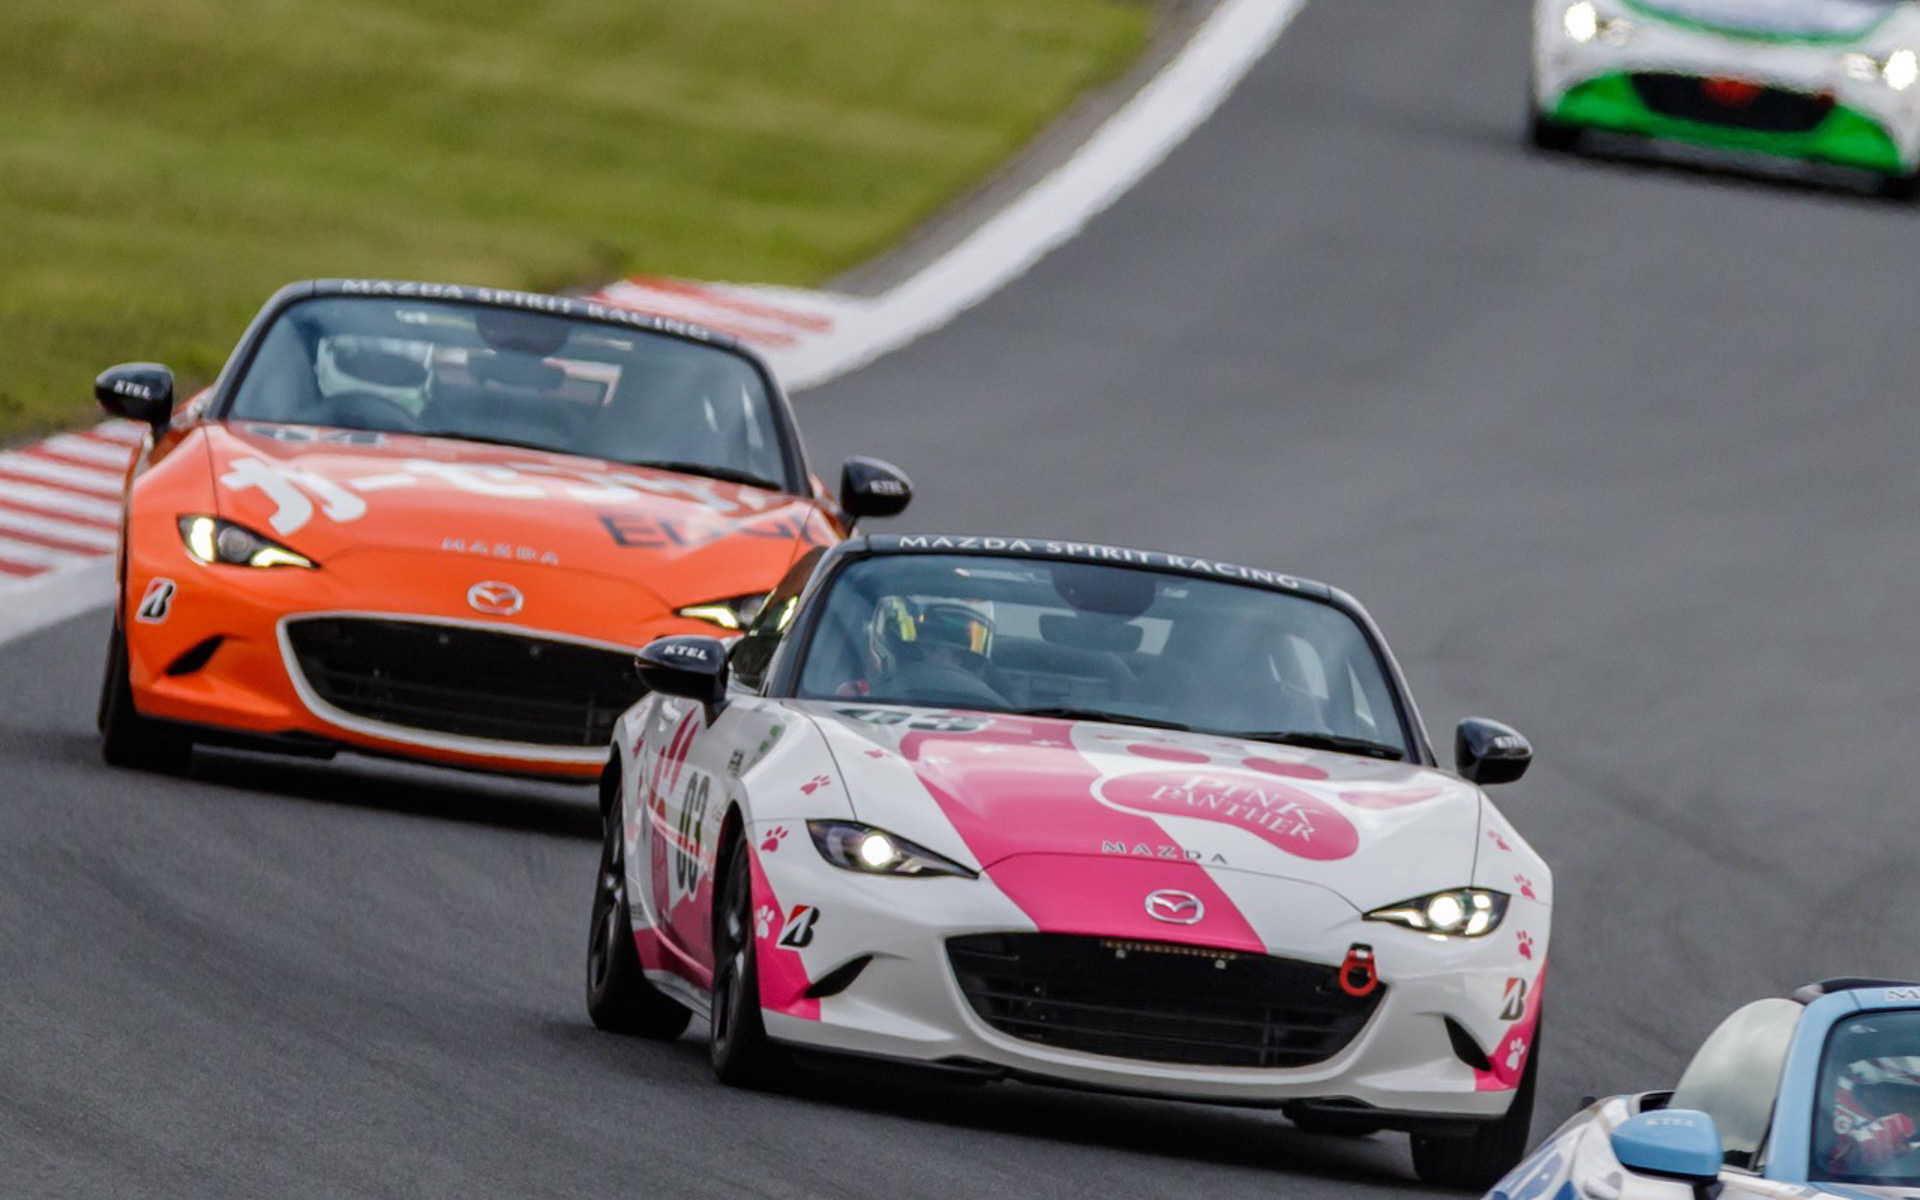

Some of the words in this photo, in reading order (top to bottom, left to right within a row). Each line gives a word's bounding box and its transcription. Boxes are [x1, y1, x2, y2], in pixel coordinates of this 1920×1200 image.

[341, 279, 463, 298] MAZDA
[478, 287, 571, 312] SPIRIT
[588, 303, 710, 341] RACING
[440, 536, 559, 567] MAZDA
[899, 534, 1033, 553] MAZDA
[1046, 541, 1152, 565] SPIRIT
[1167, 553, 1301, 590] RACING
[663, 644, 708, 661] KTEL
[1151, 784, 1315, 842] PANTHER
[1181, 775, 1321, 826] PINK
[1101, 839, 1228, 865] MAZDA
